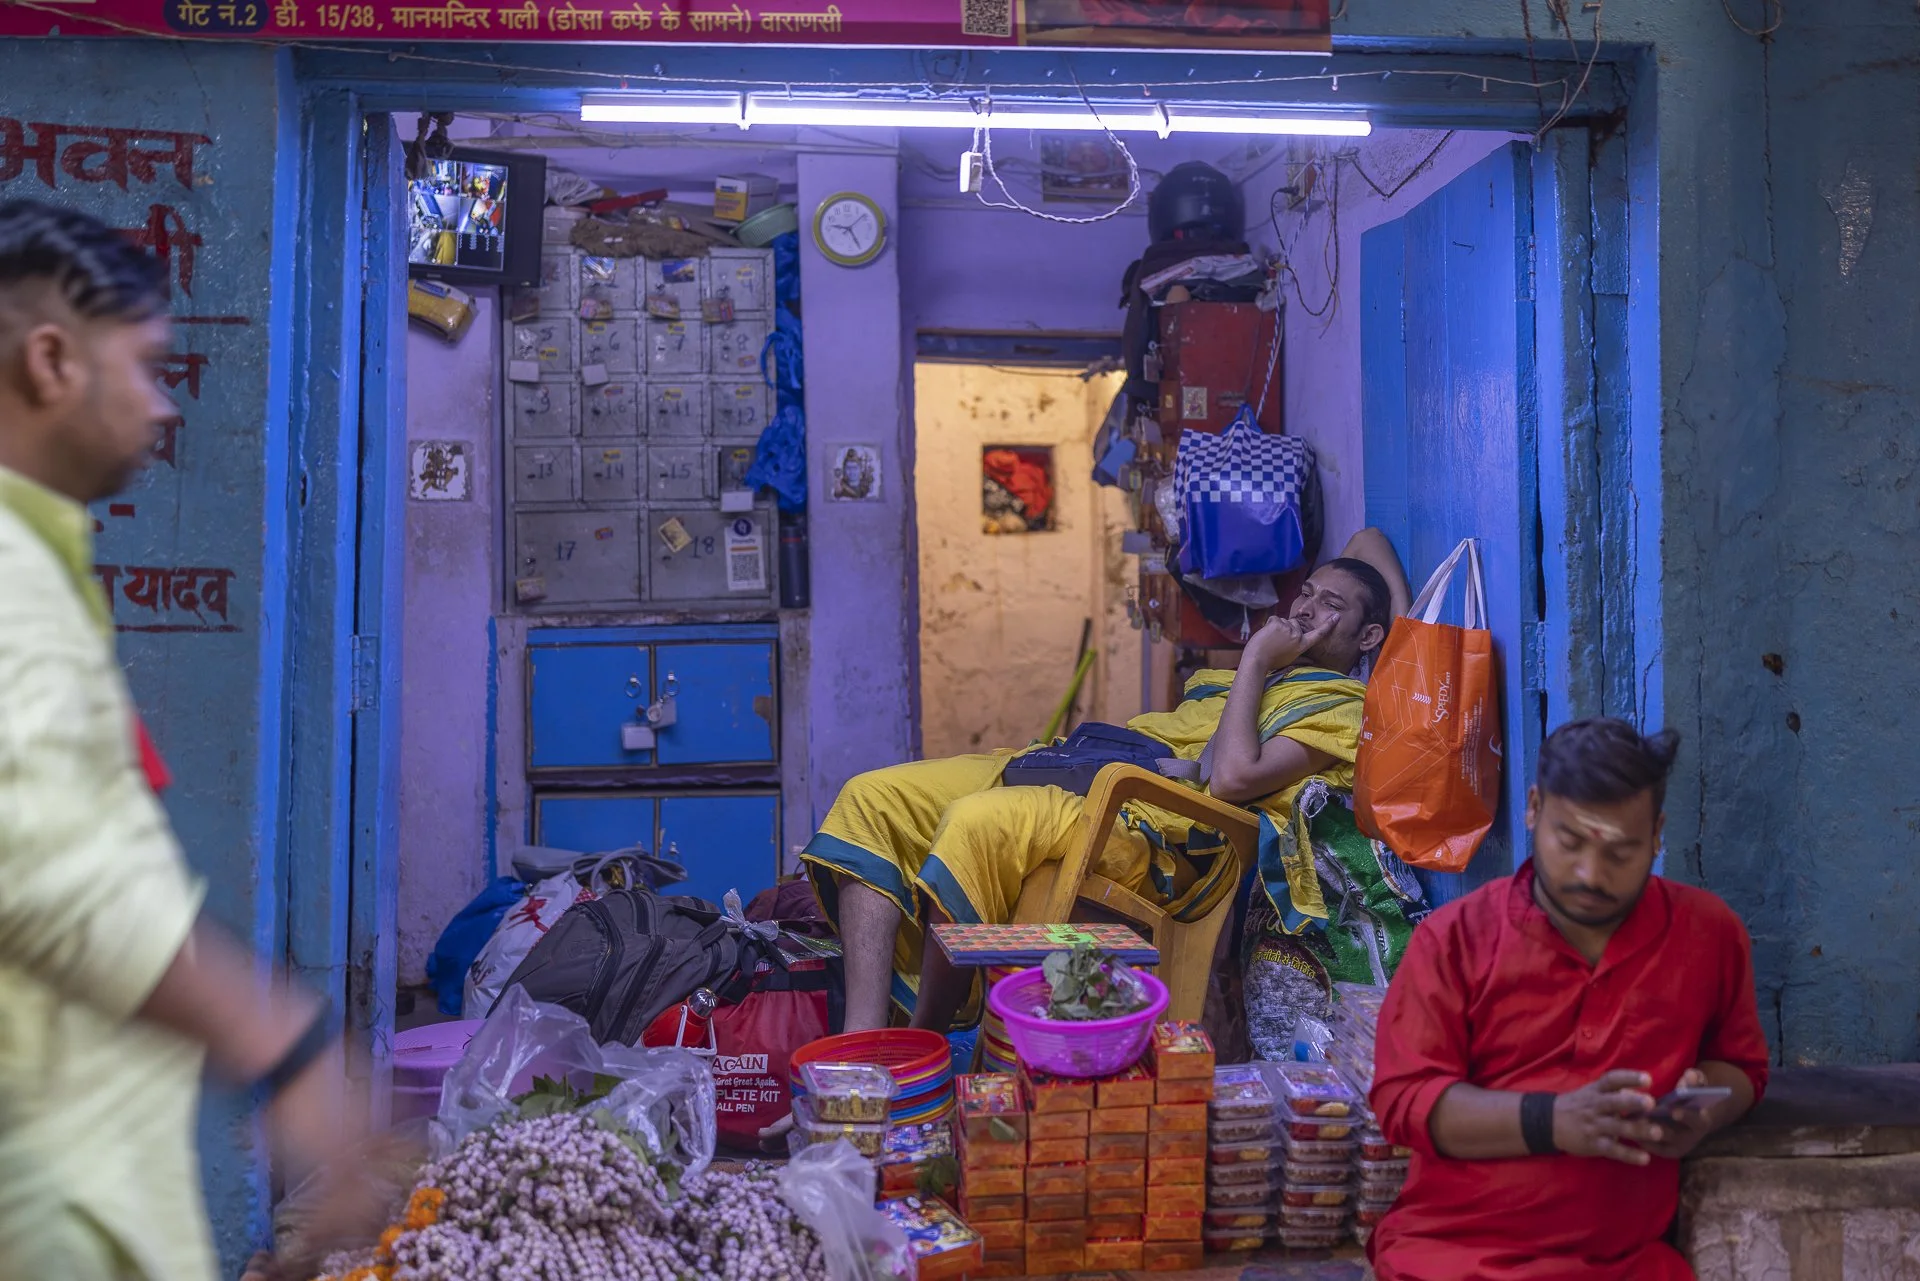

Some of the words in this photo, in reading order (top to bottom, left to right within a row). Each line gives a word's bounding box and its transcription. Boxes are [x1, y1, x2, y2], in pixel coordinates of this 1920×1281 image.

[178, 2, 211, 26] गेट
[274, 0, 306, 27] डी.
[317, 5, 383, 31] 15/38,
[392, 2, 491, 29] मानमन्दिर
[499, 2, 539, 30] गली
[548, 1, 602, 31] (डोसा
[659, 4, 680, 31] के
[688, 4, 751, 33] सामने)
[759, 4, 842, 33] वाराणसी
[608, 331, 620, 351] 6
[604, 464, 624, 479] 14
[670, 463, 693, 479] 15
[556, 541, 577, 561] 17
[691, 536, 715, 558] 18
[124, 565, 236, 624] यादव
[1282, 953, 1290, 964] से
[712, 1056, 765, 1072] AGAIN
[716, 1089, 758, 1101] PLETE
[760, 1090, 780, 1103] KIT
[716, 1102, 733, 1112] ALL
[735, 1103, 755, 1113] PEN
